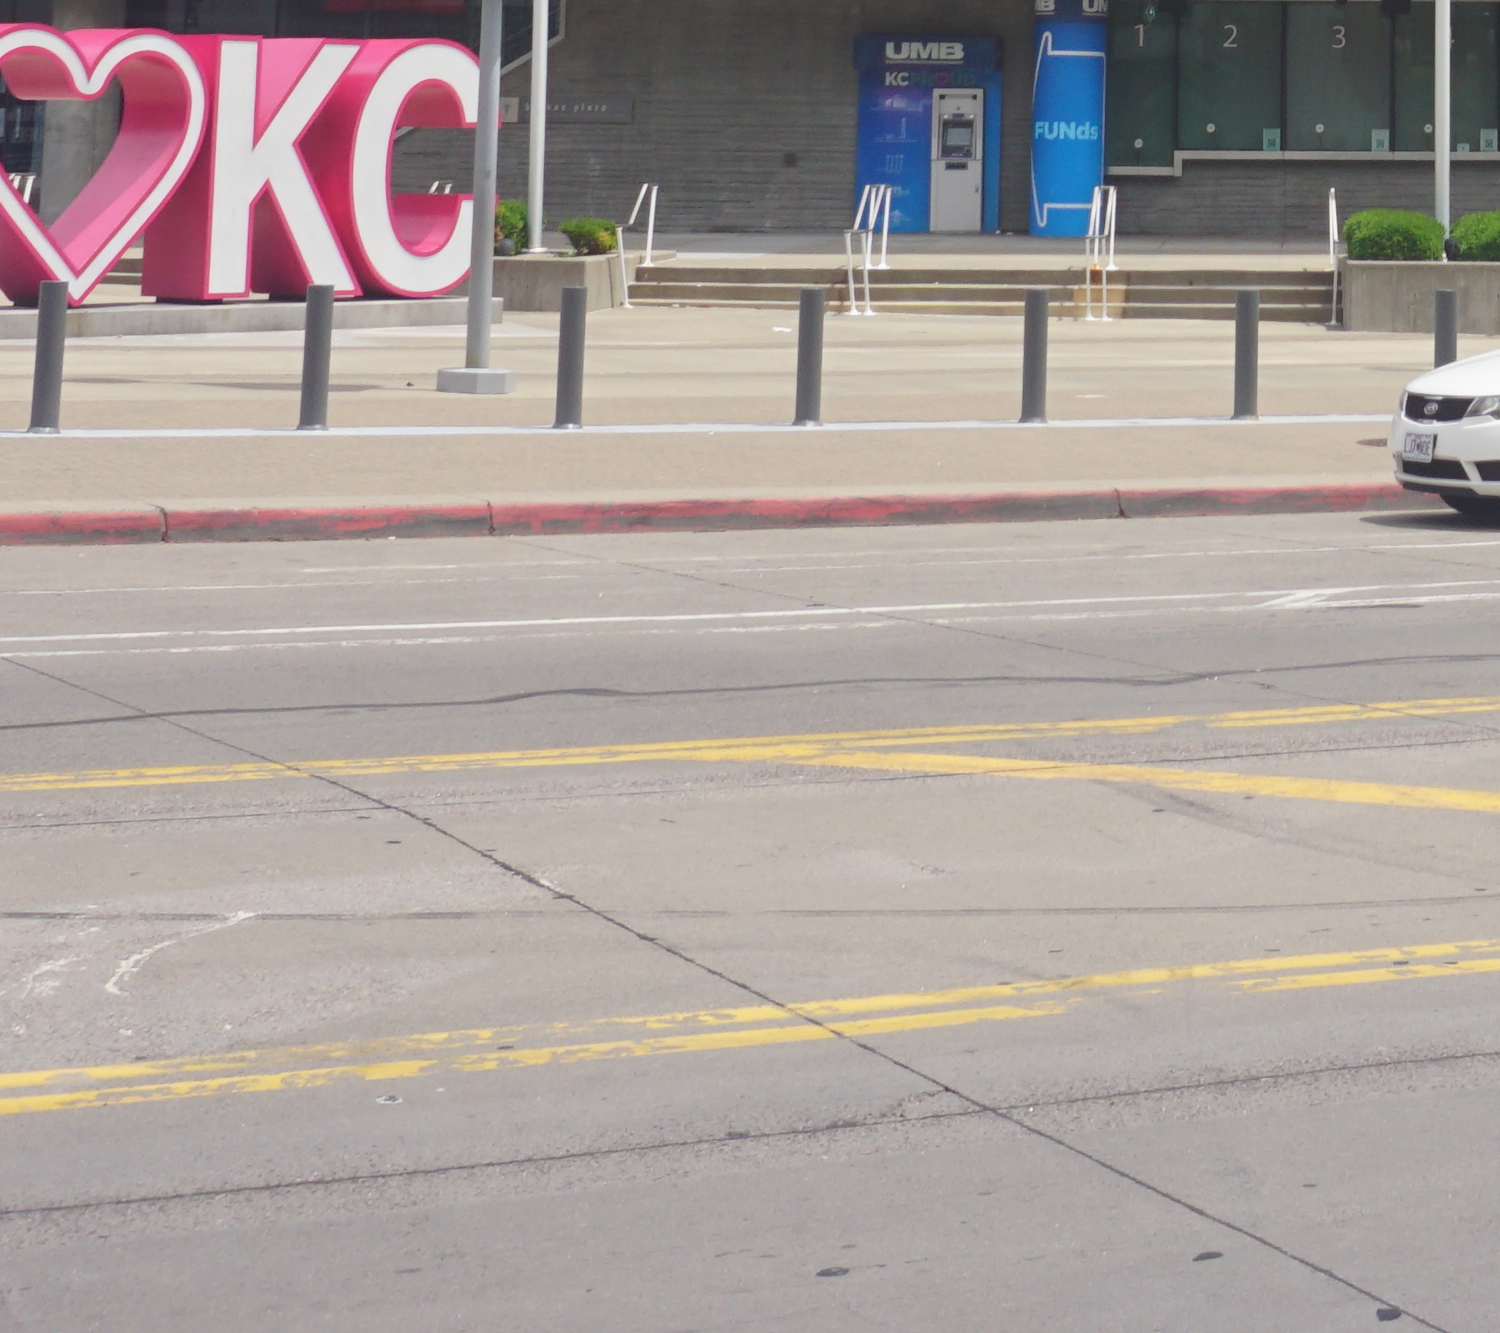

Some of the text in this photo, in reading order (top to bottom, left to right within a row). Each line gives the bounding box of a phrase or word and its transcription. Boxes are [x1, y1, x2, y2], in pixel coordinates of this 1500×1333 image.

[1133, 24, 1146, 48] 1
[1222, 25, 1240, 48] 2
[1331, 25, 1346, 49] 3
[885, 41, 965, 60] UMB
[1035, 121, 1099, 141] FUNds
